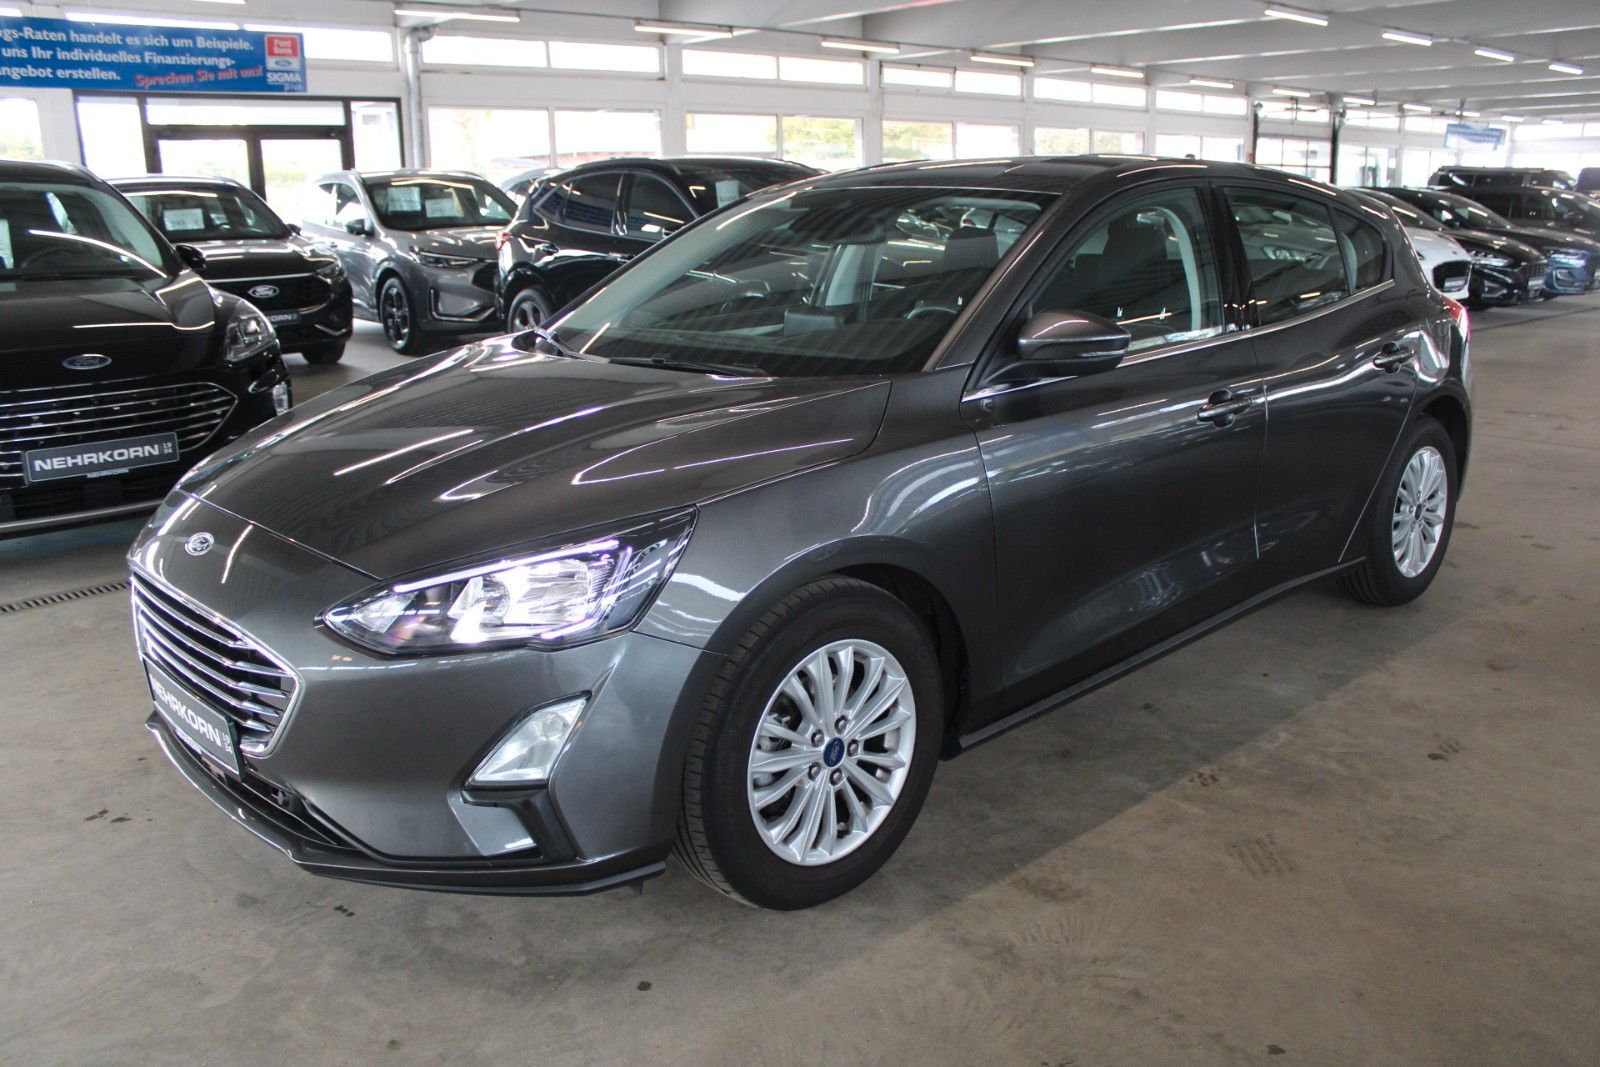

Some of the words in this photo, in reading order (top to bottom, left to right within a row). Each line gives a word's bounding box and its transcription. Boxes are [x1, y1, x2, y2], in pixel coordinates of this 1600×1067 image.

[0, 26, 67, 41] gs-Raten
[70, 30, 122, 44] handelt
[126, 36, 141, 45] es
[144, 34, 169, 47] sich
[172, 38, 193, 48] um
[196, 36, 254, 52] Beispiele.
[2, 47, 28, 58] uns
[31, 46, 54, 59] Ihr
[56, 47, 141, 63] individuelles
[144, 51, 236, 69] Finanzierungs-
[0, 64, 53, 80] ngebot
[56, 67, 121, 80] erstellen.
[266, 71, 302, 82] SIGMA
[34, 444, 159, 471] NEHRKORN
[149, 673, 221, 747] NEHRKORN
